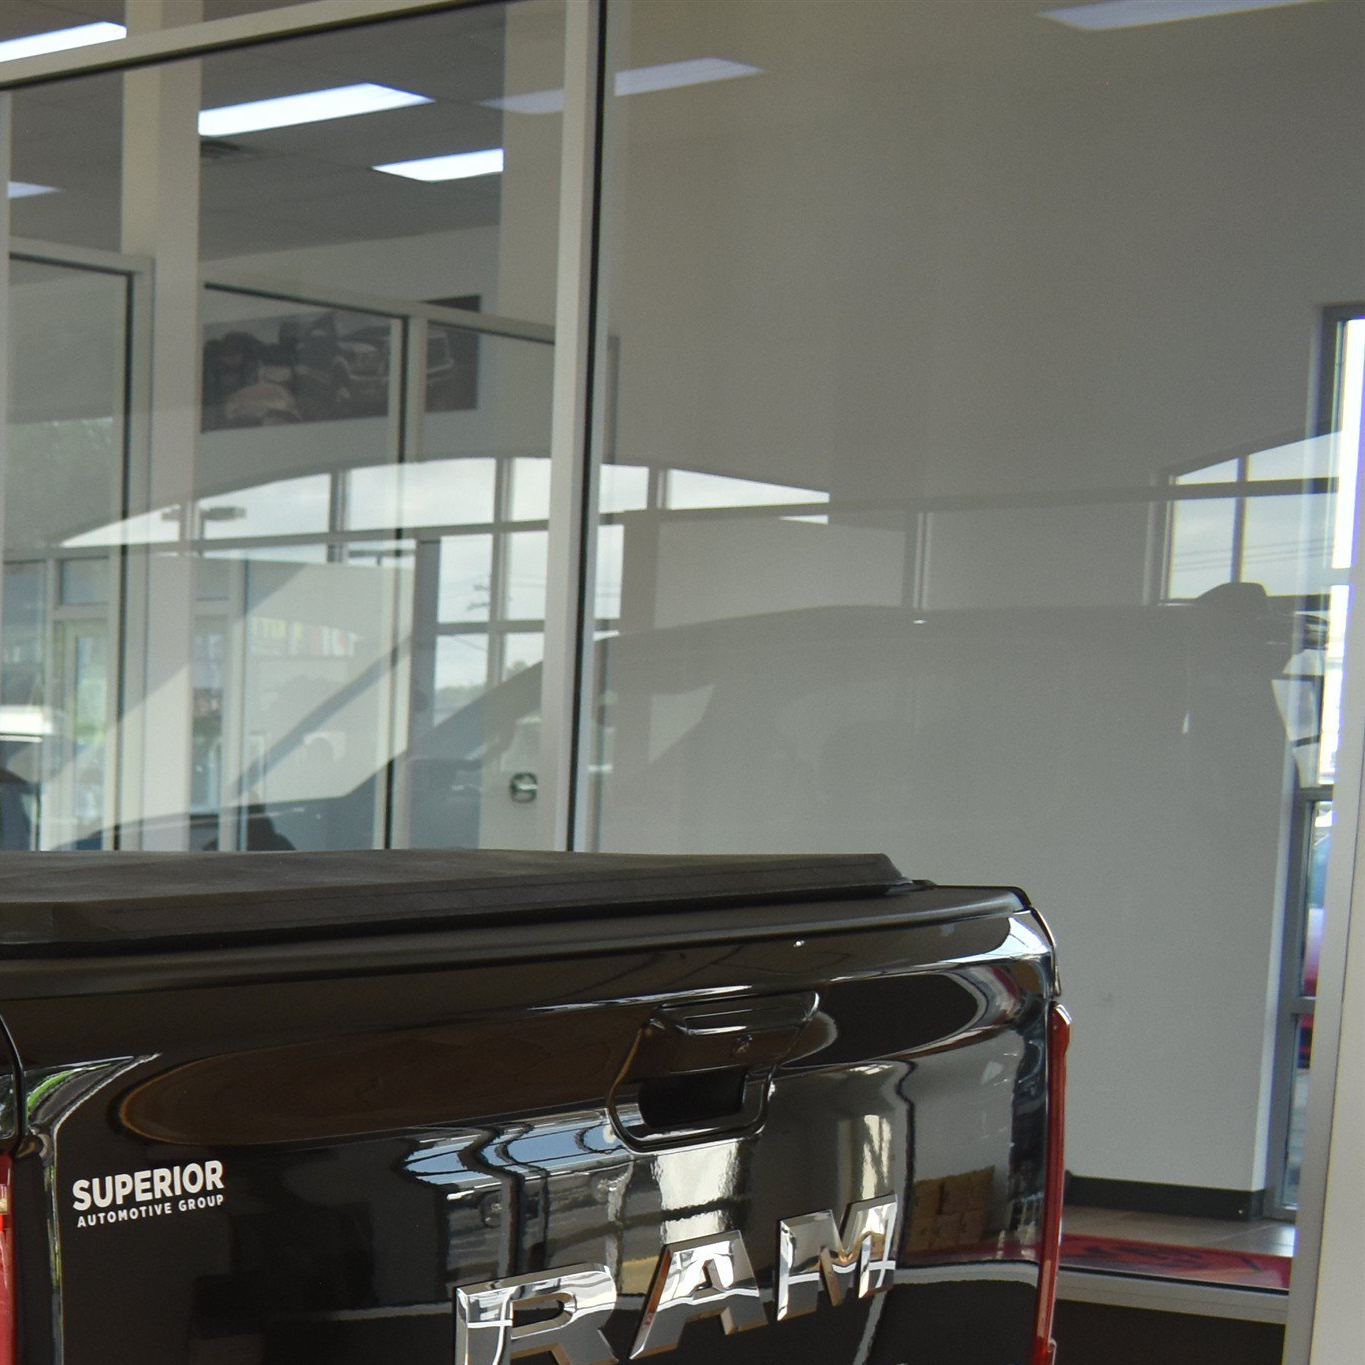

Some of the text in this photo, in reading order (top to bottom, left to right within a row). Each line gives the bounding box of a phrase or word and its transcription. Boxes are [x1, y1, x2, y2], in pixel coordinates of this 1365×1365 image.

[72, 1160, 225, 1211] SUPERIOR
[77, 1194, 224, 1228] AUTOMOTIVE GROUP
